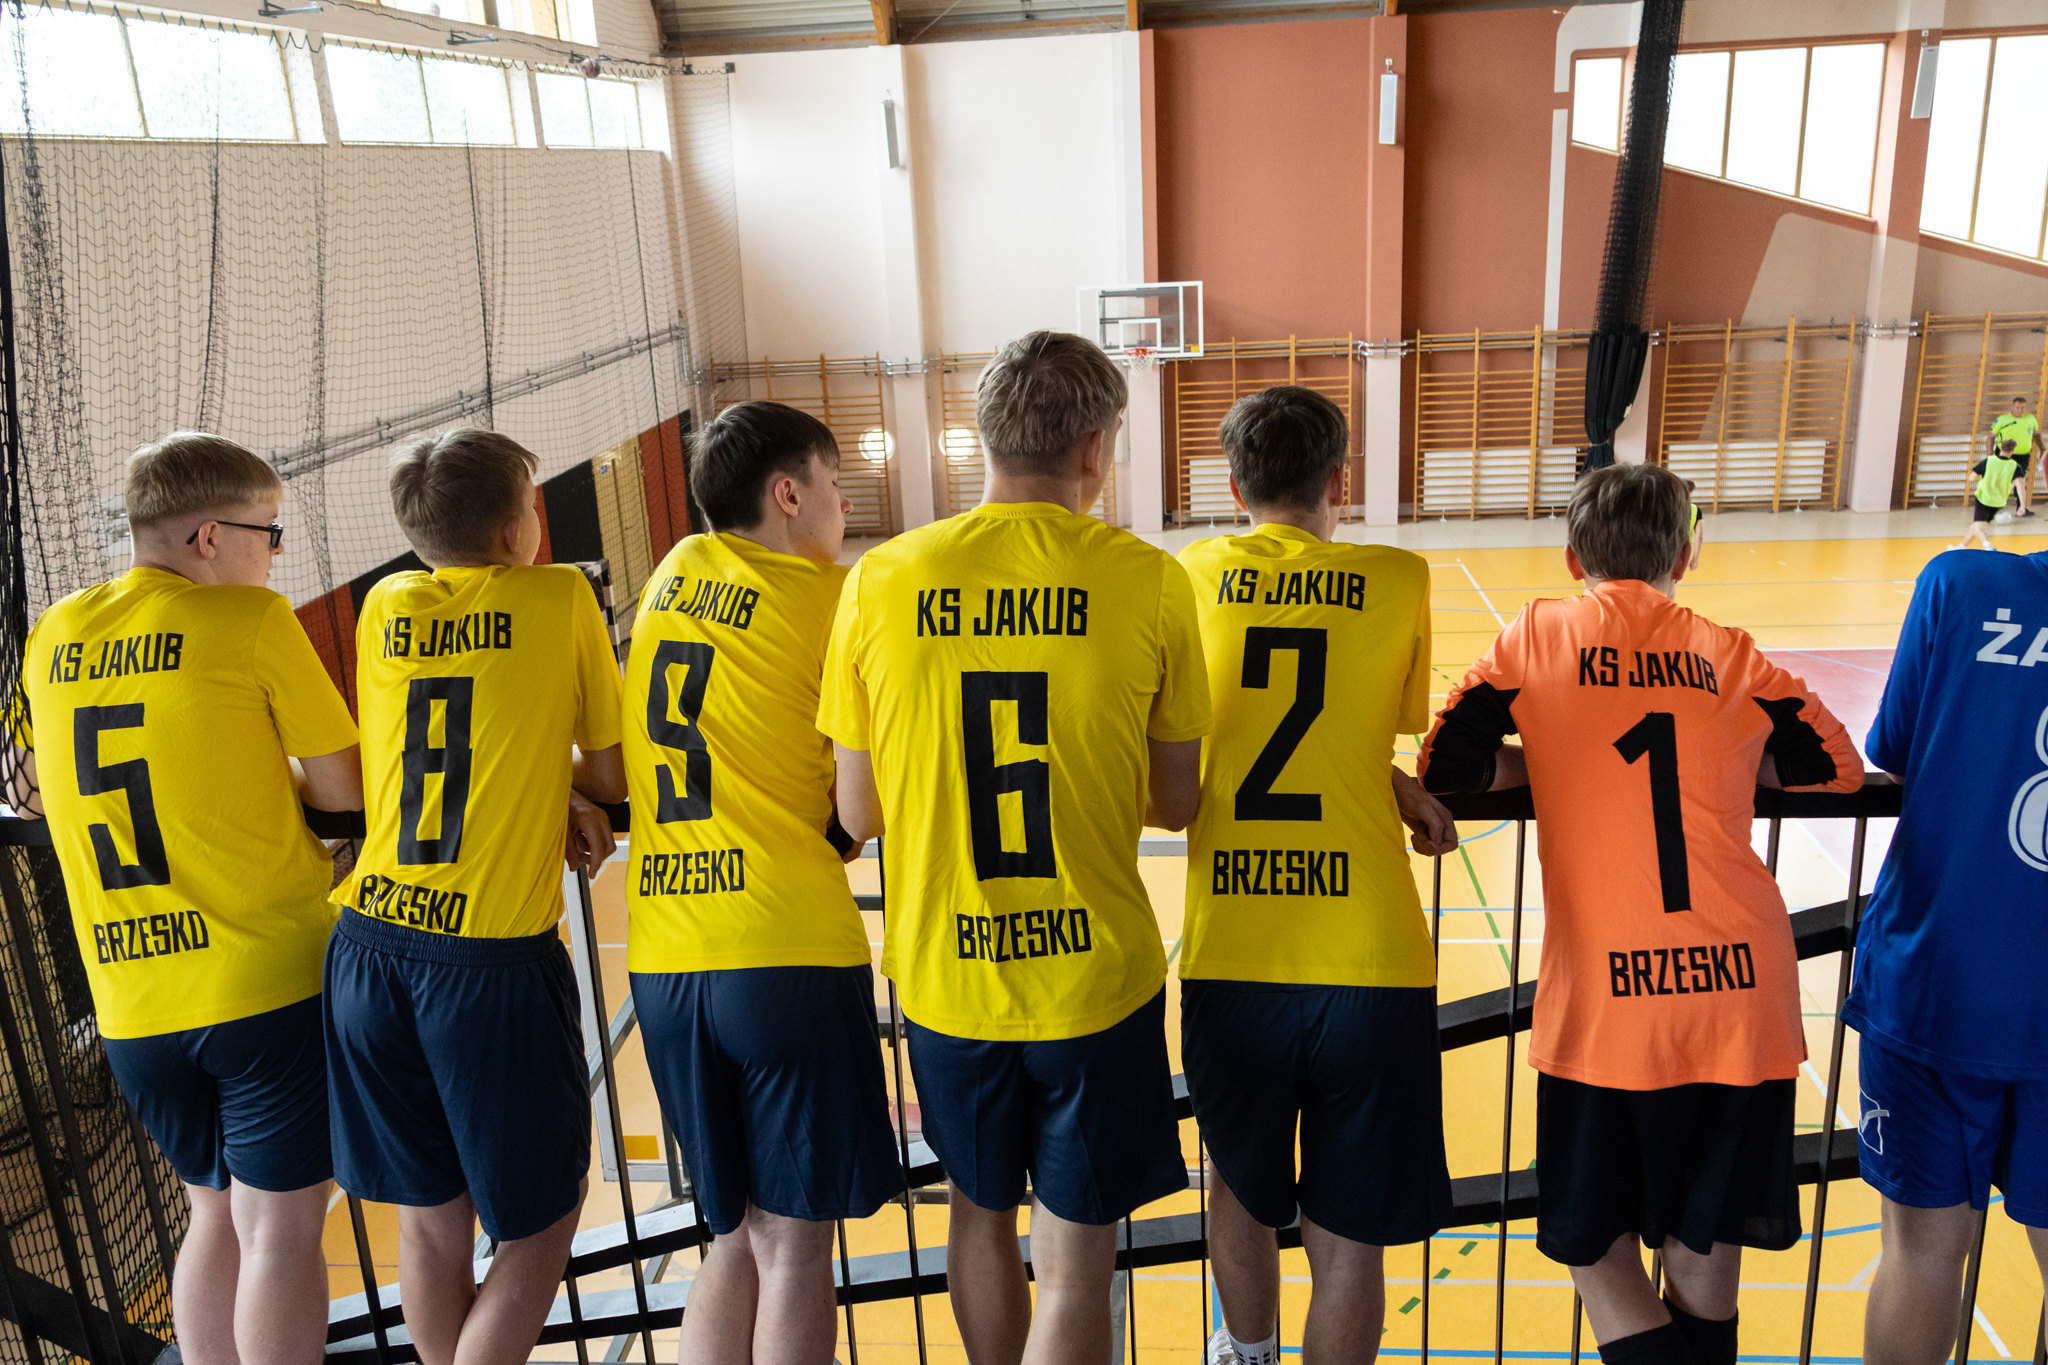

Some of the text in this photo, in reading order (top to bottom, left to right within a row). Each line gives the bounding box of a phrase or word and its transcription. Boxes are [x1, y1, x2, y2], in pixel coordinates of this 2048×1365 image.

[649, 576, 760, 630] KS JAKUB
[917, 587, 1088, 637] KS JAKUB
[1218, 569, 1366, 611] KS JAKUB
[49, 633, 184, 684] KS JAKUB
[383, 612, 512, 659] KS JAKUB
[1579, 646, 1719, 696] KS JAKUB
[647, 640, 715, 824] 9
[1234, 627, 1328, 821] 2
[73, 703, 171, 891] 5
[398, 676, 474, 865] 8
[961, 671, 1057, 882] 6
[1612, 711, 1692, 914] 1
[640, 849, 745, 897] BRZESKO
[1212, 849, 1349, 897] BRZESKO
[360, 873, 469, 936] BRZESKO
[93, 910, 209, 964] BRZESKO
[957, 908, 1092, 963] BRZESKO
[1609, 943, 1756, 997] BRZESKO
